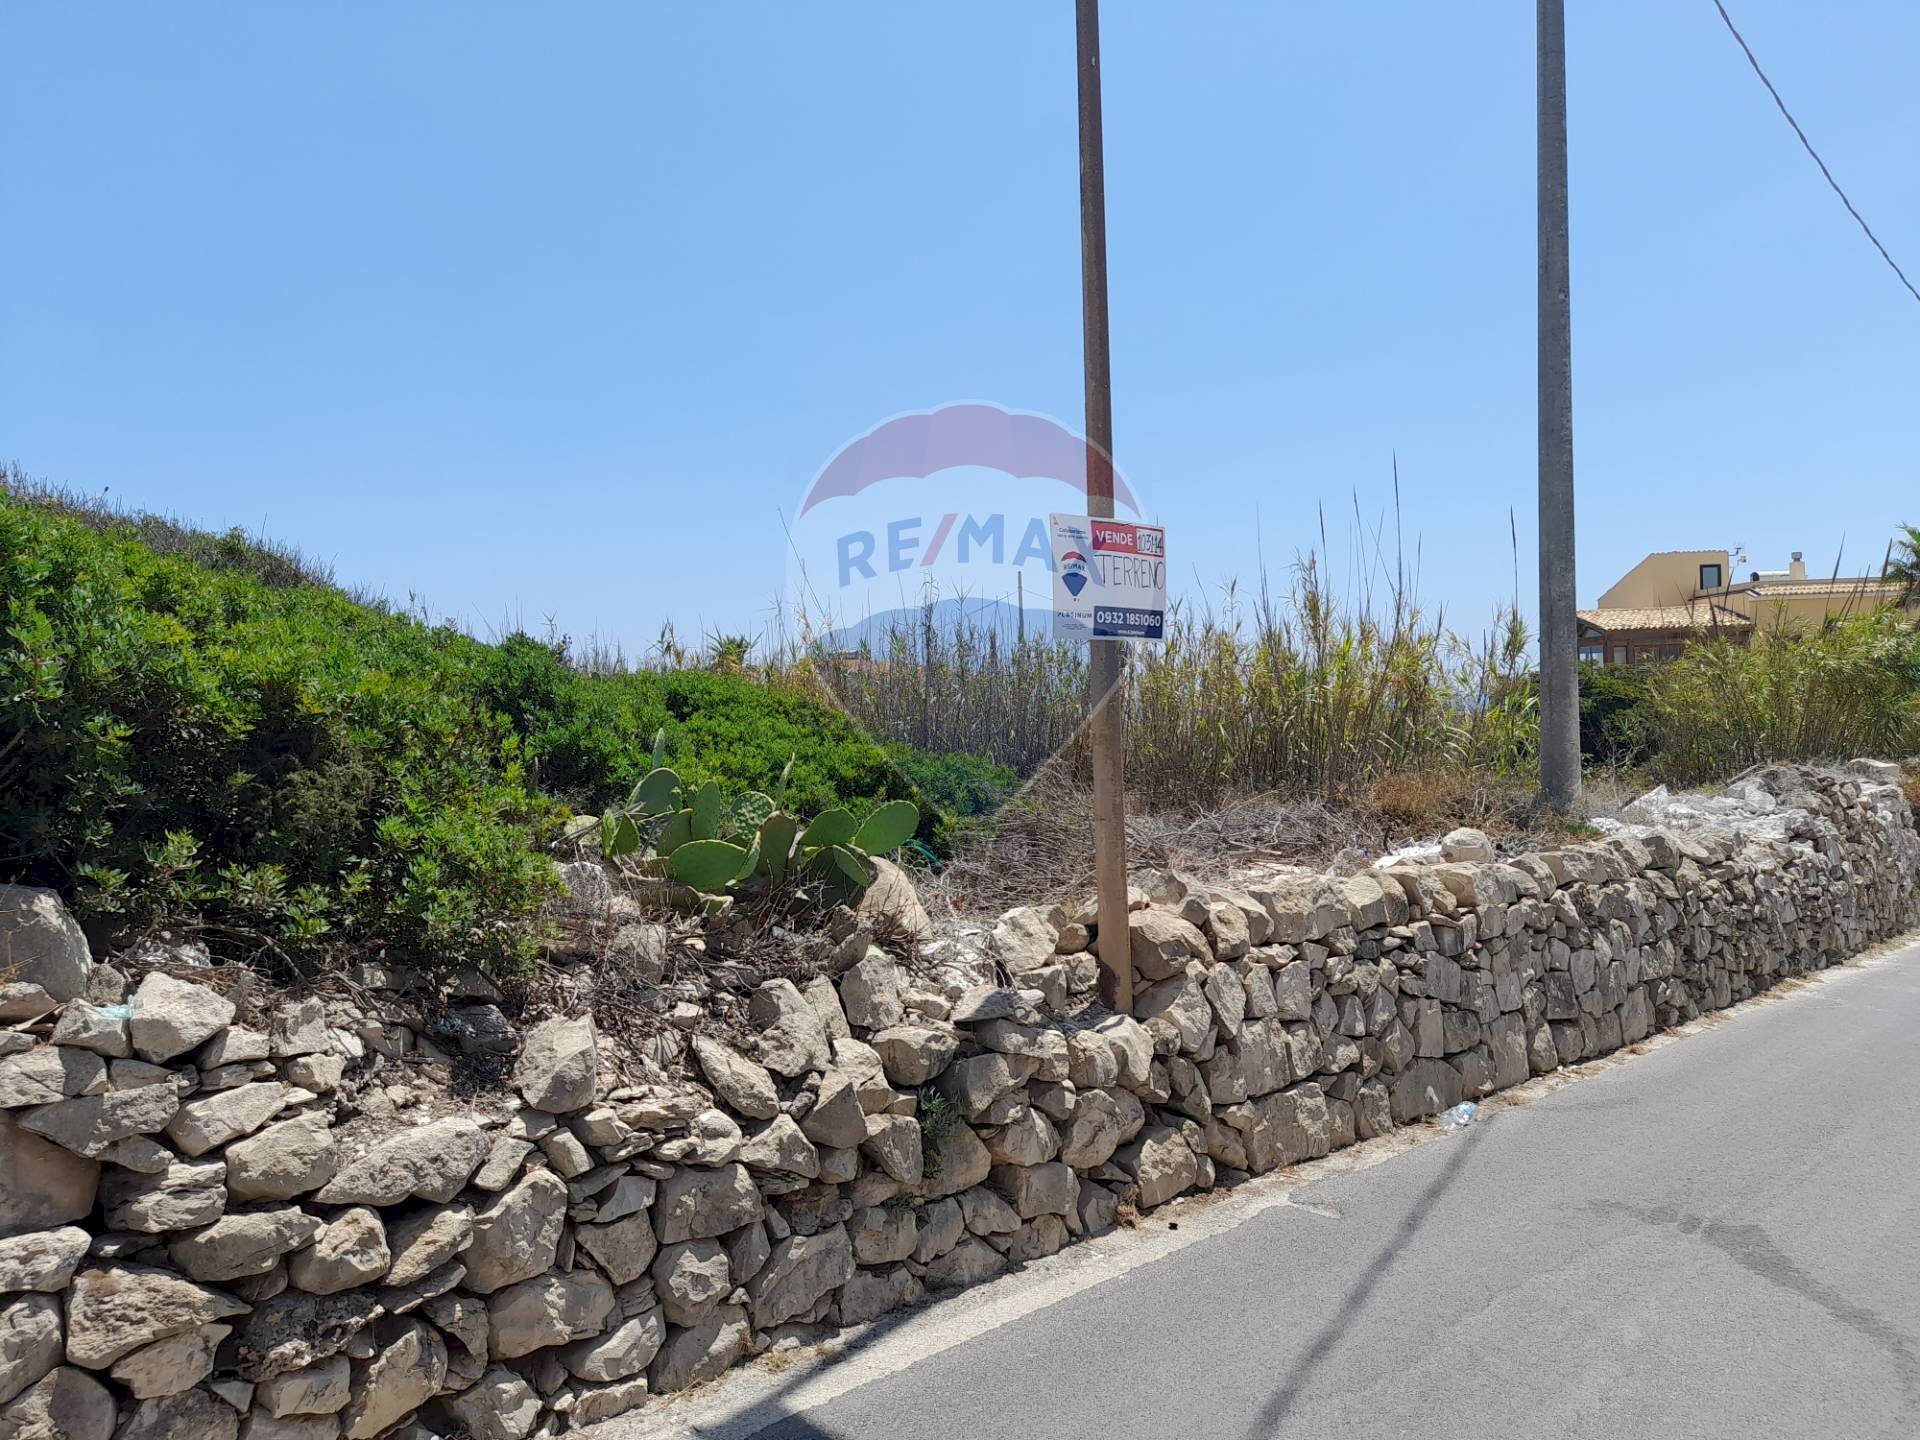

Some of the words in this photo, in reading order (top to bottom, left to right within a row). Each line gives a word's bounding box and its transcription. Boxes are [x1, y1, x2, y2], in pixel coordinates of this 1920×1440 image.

[1096, 530, 1134, 546] VENDE
[1094, 554, 1166, 591] TERRENO
[1057, 611, 1092, 619] PLATINUM
[1096, 611, 1124, 625] 0932
[1126, 612, 1161, 627] 1851060
